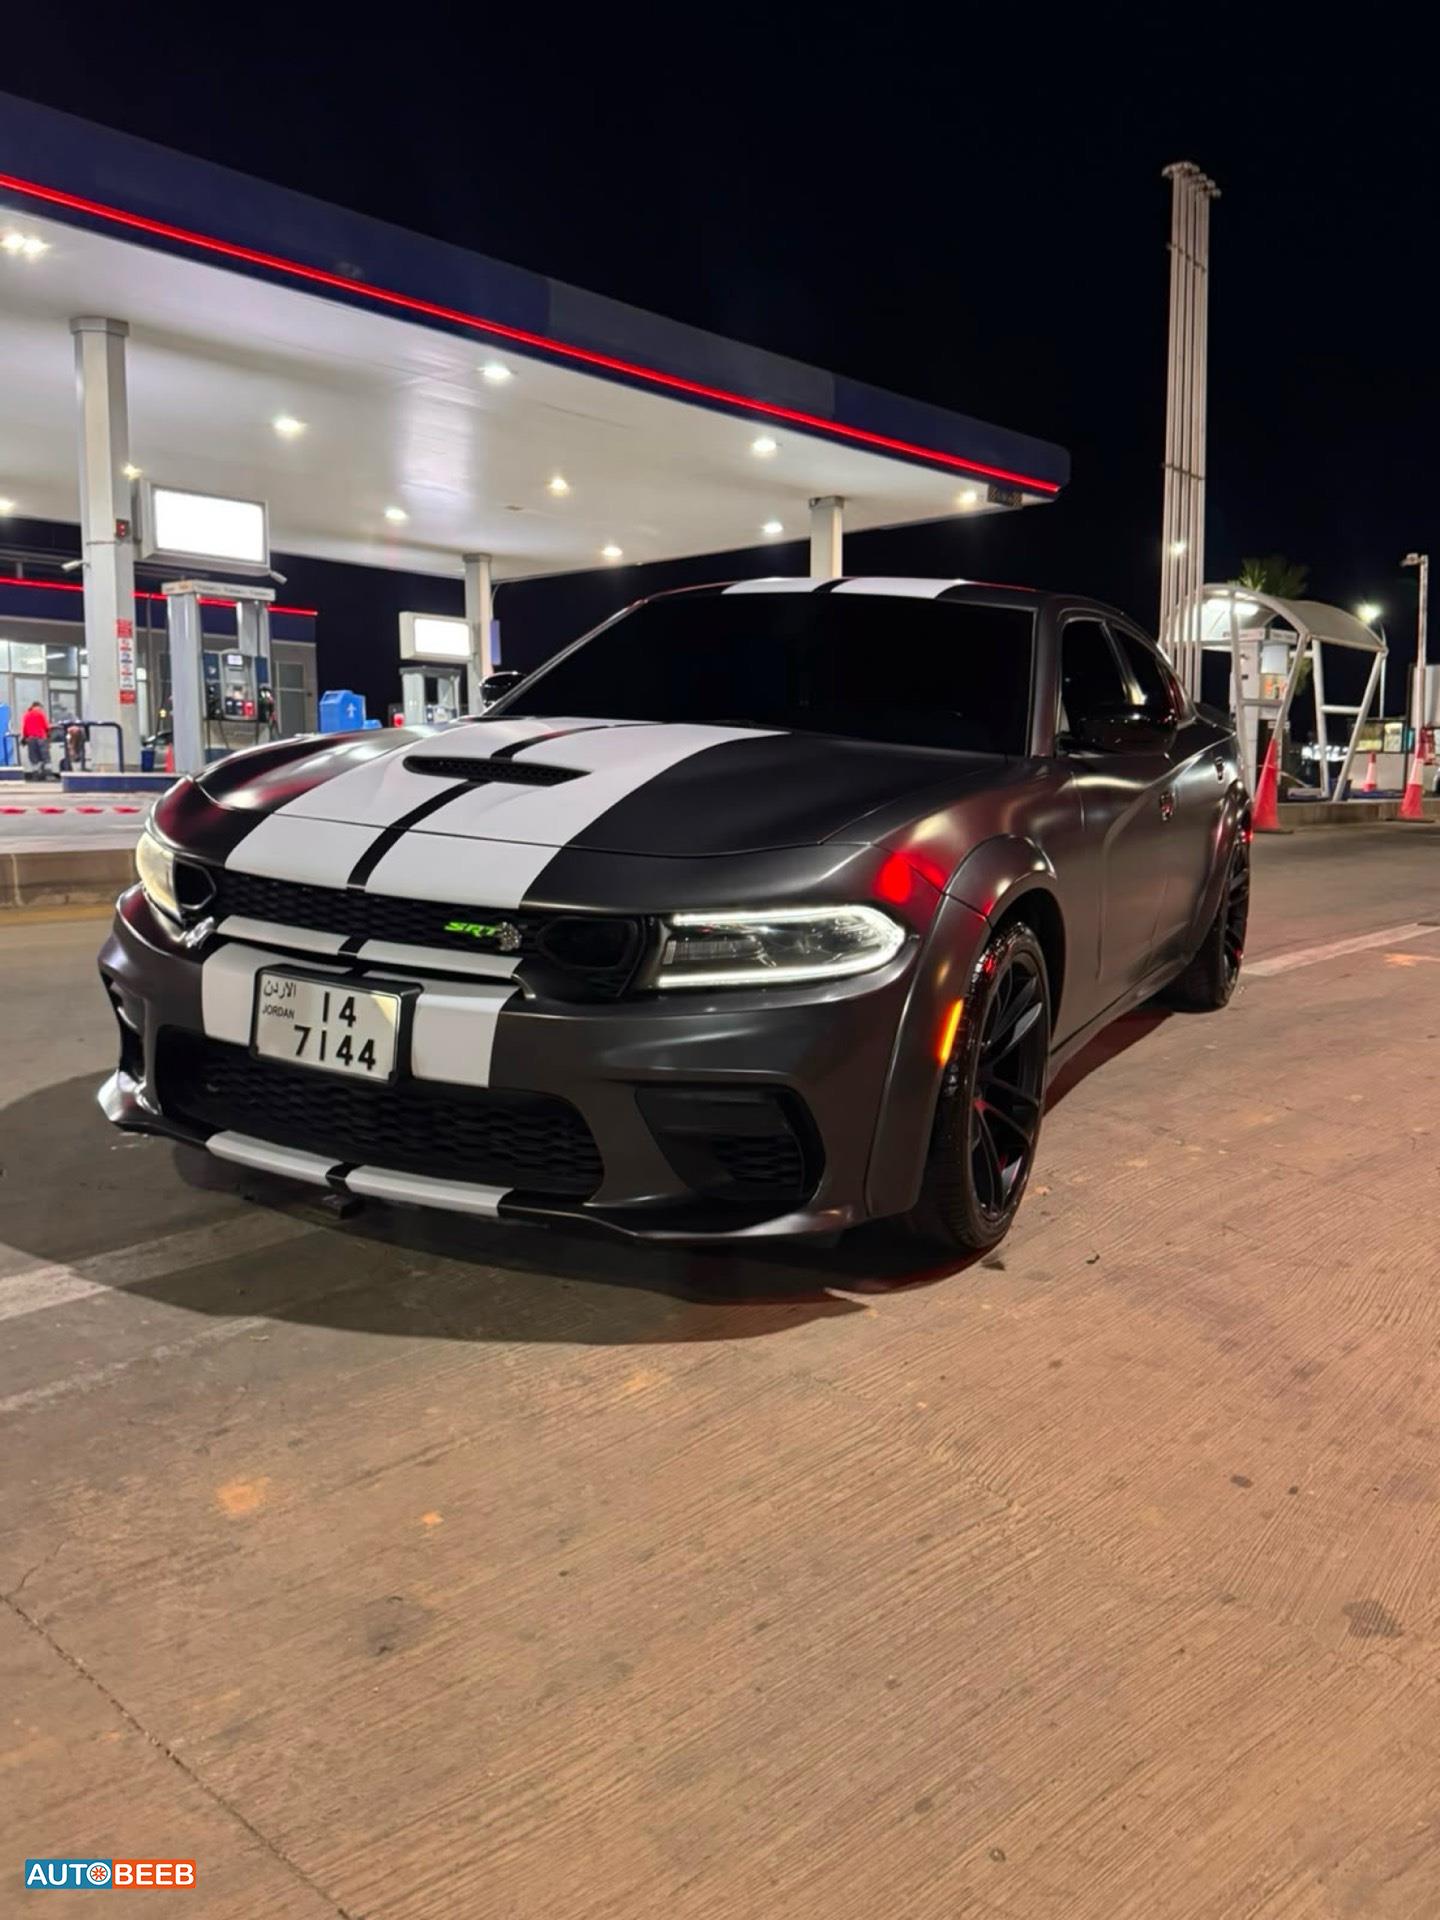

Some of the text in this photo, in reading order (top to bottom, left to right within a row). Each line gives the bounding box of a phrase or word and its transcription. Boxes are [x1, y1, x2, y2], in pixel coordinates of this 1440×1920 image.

[444, 921, 502, 938] SRT
[262, 1004, 295, 1020] JORDAN
[322, 991, 356, 1028] 14
[294, 1024, 376, 1071] 7144
